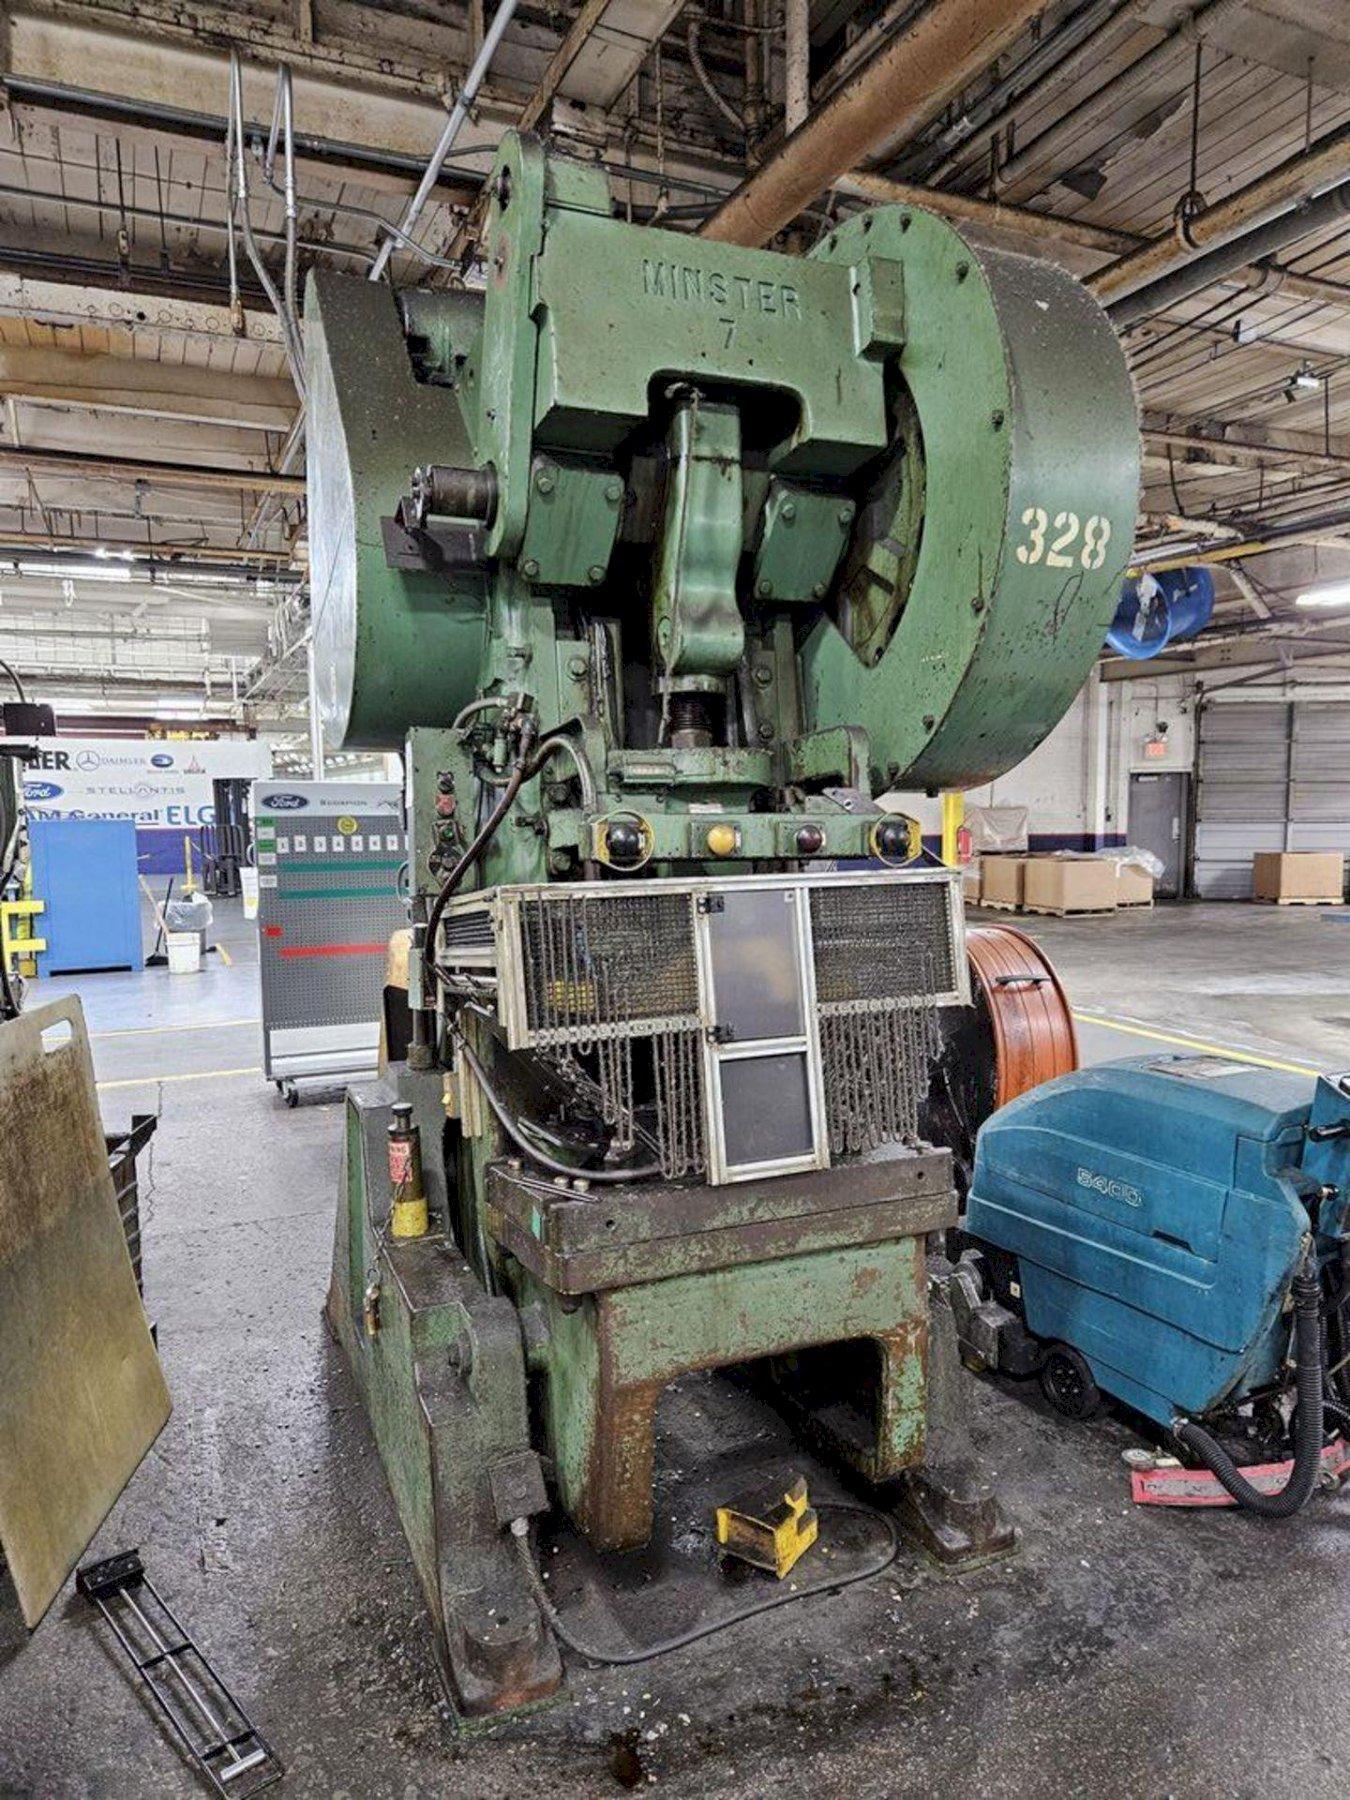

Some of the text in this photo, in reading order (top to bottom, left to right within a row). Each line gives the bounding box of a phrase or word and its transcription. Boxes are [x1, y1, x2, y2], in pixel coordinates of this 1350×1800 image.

[643, 258, 802, 320] MINSTER
[719, 317, 735, 350] 7
[1016, 507, 1111, 570] 328
[86, 786, 186, 795] STELLANTIS
